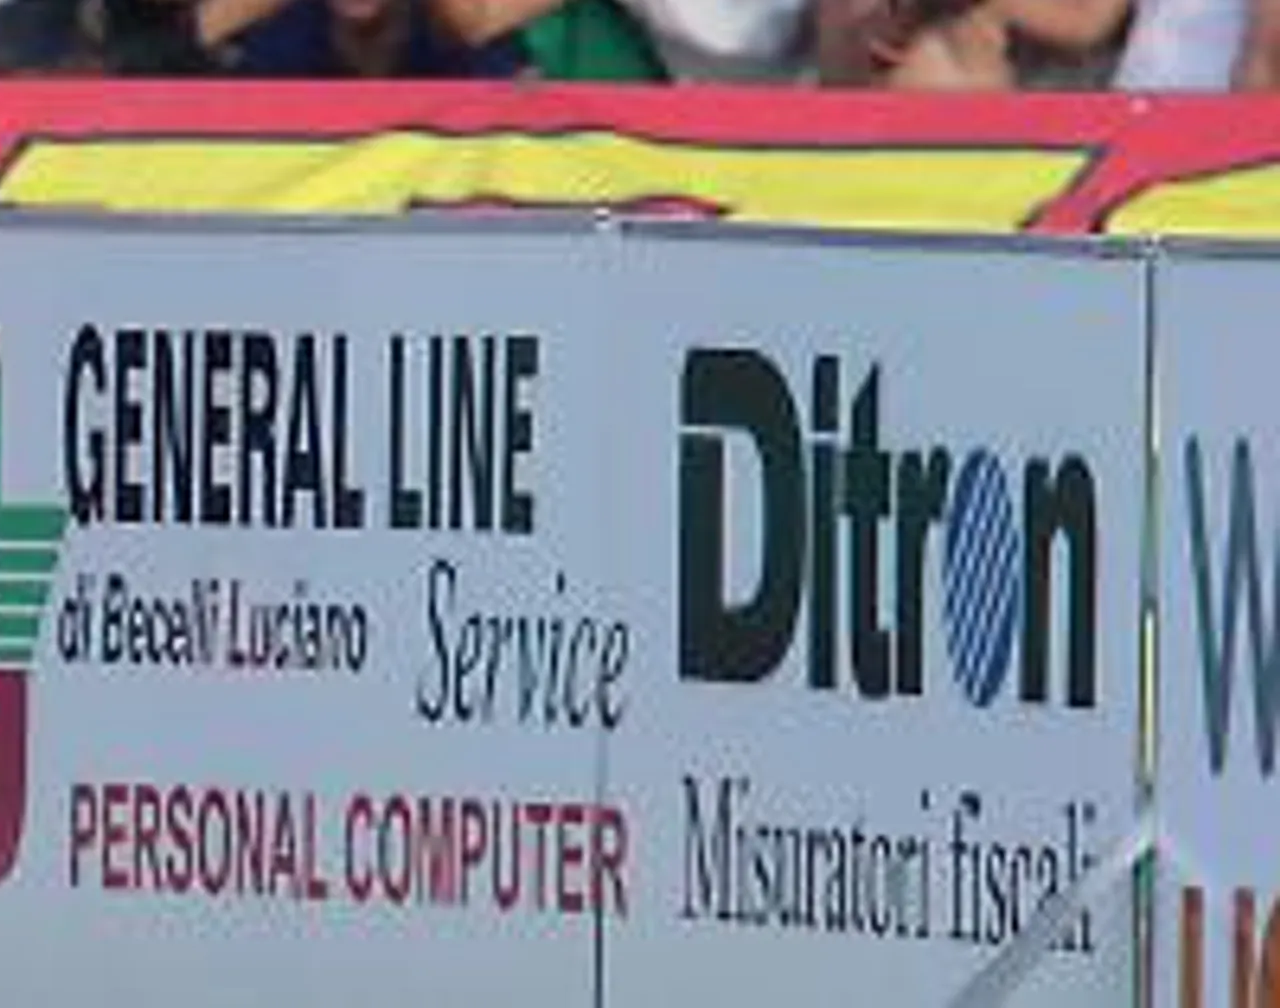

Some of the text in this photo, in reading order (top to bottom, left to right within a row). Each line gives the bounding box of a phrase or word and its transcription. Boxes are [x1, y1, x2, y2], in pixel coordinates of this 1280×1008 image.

[64, 324, 540, 535] GENERAL LINE
[678, 347, 1097, 709] Ditron
[57, 572, 92, 664] di
[230, 578, 368, 673] Luciano
[416, 558, 631, 730] Service
[69, 783, 630, 920] PERSONAL COMPUTER
[679, 774, 931, 939] Misuratori
[948, 789, 1096, 952] fiscali
